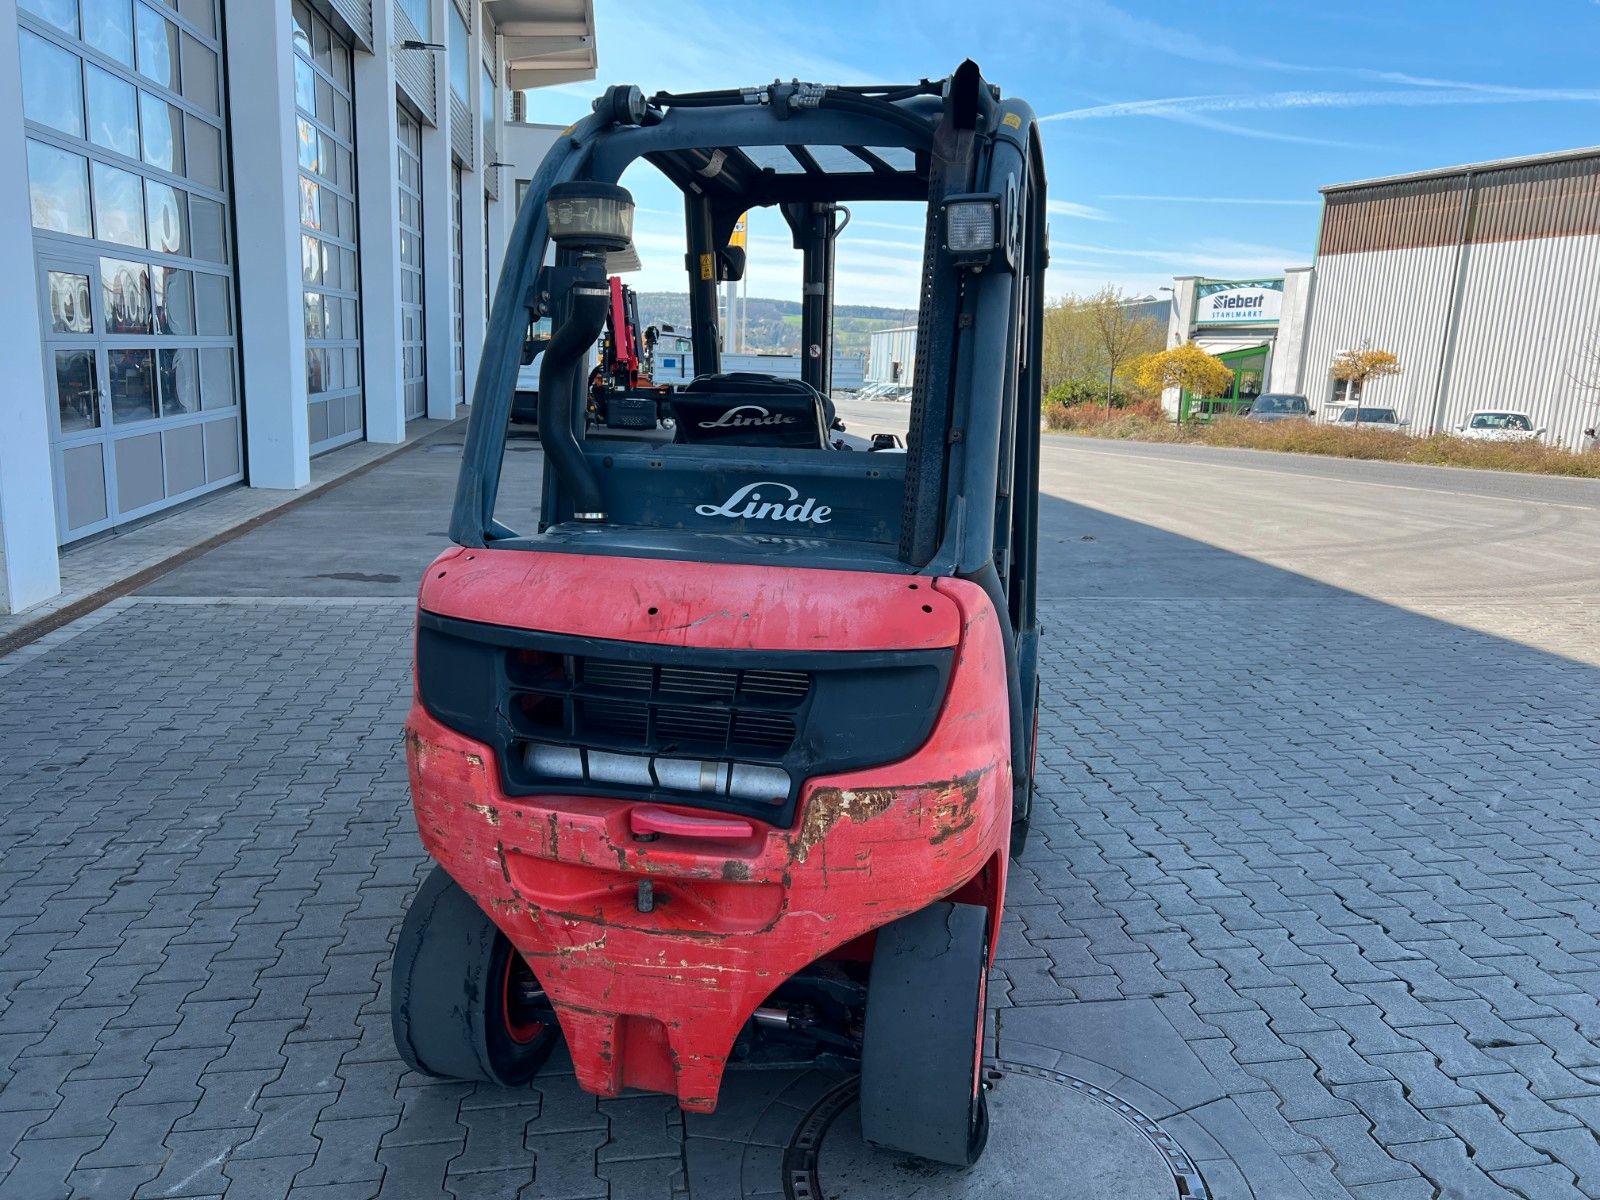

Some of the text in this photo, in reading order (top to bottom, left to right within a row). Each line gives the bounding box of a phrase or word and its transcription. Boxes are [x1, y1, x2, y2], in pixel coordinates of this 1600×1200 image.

[1213, 294, 1264, 309] Siebert
[1212, 310, 1263, 319] STAHLMARKT
[698, 405, 799, 428] Linde
[695, 481, 832, 523] Linde
